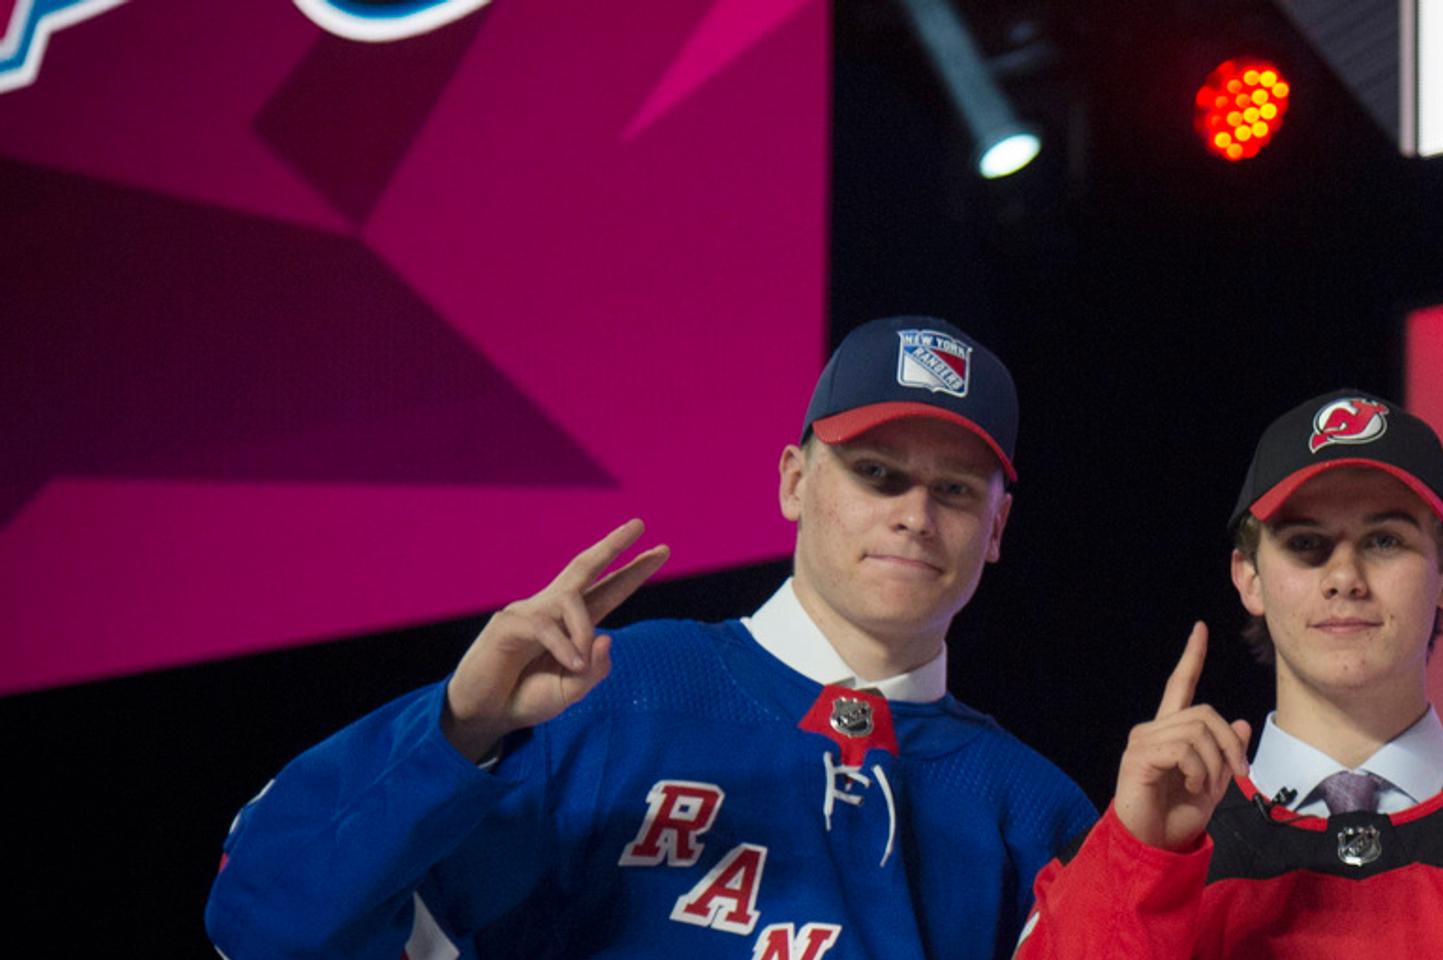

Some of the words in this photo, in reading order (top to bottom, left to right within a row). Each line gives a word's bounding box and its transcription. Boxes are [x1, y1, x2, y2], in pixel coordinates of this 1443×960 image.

[903, 333, 934, 347] NEW
[935, 337, 967, 359] YORK
[912, 346, 963, 391] RANGERS
